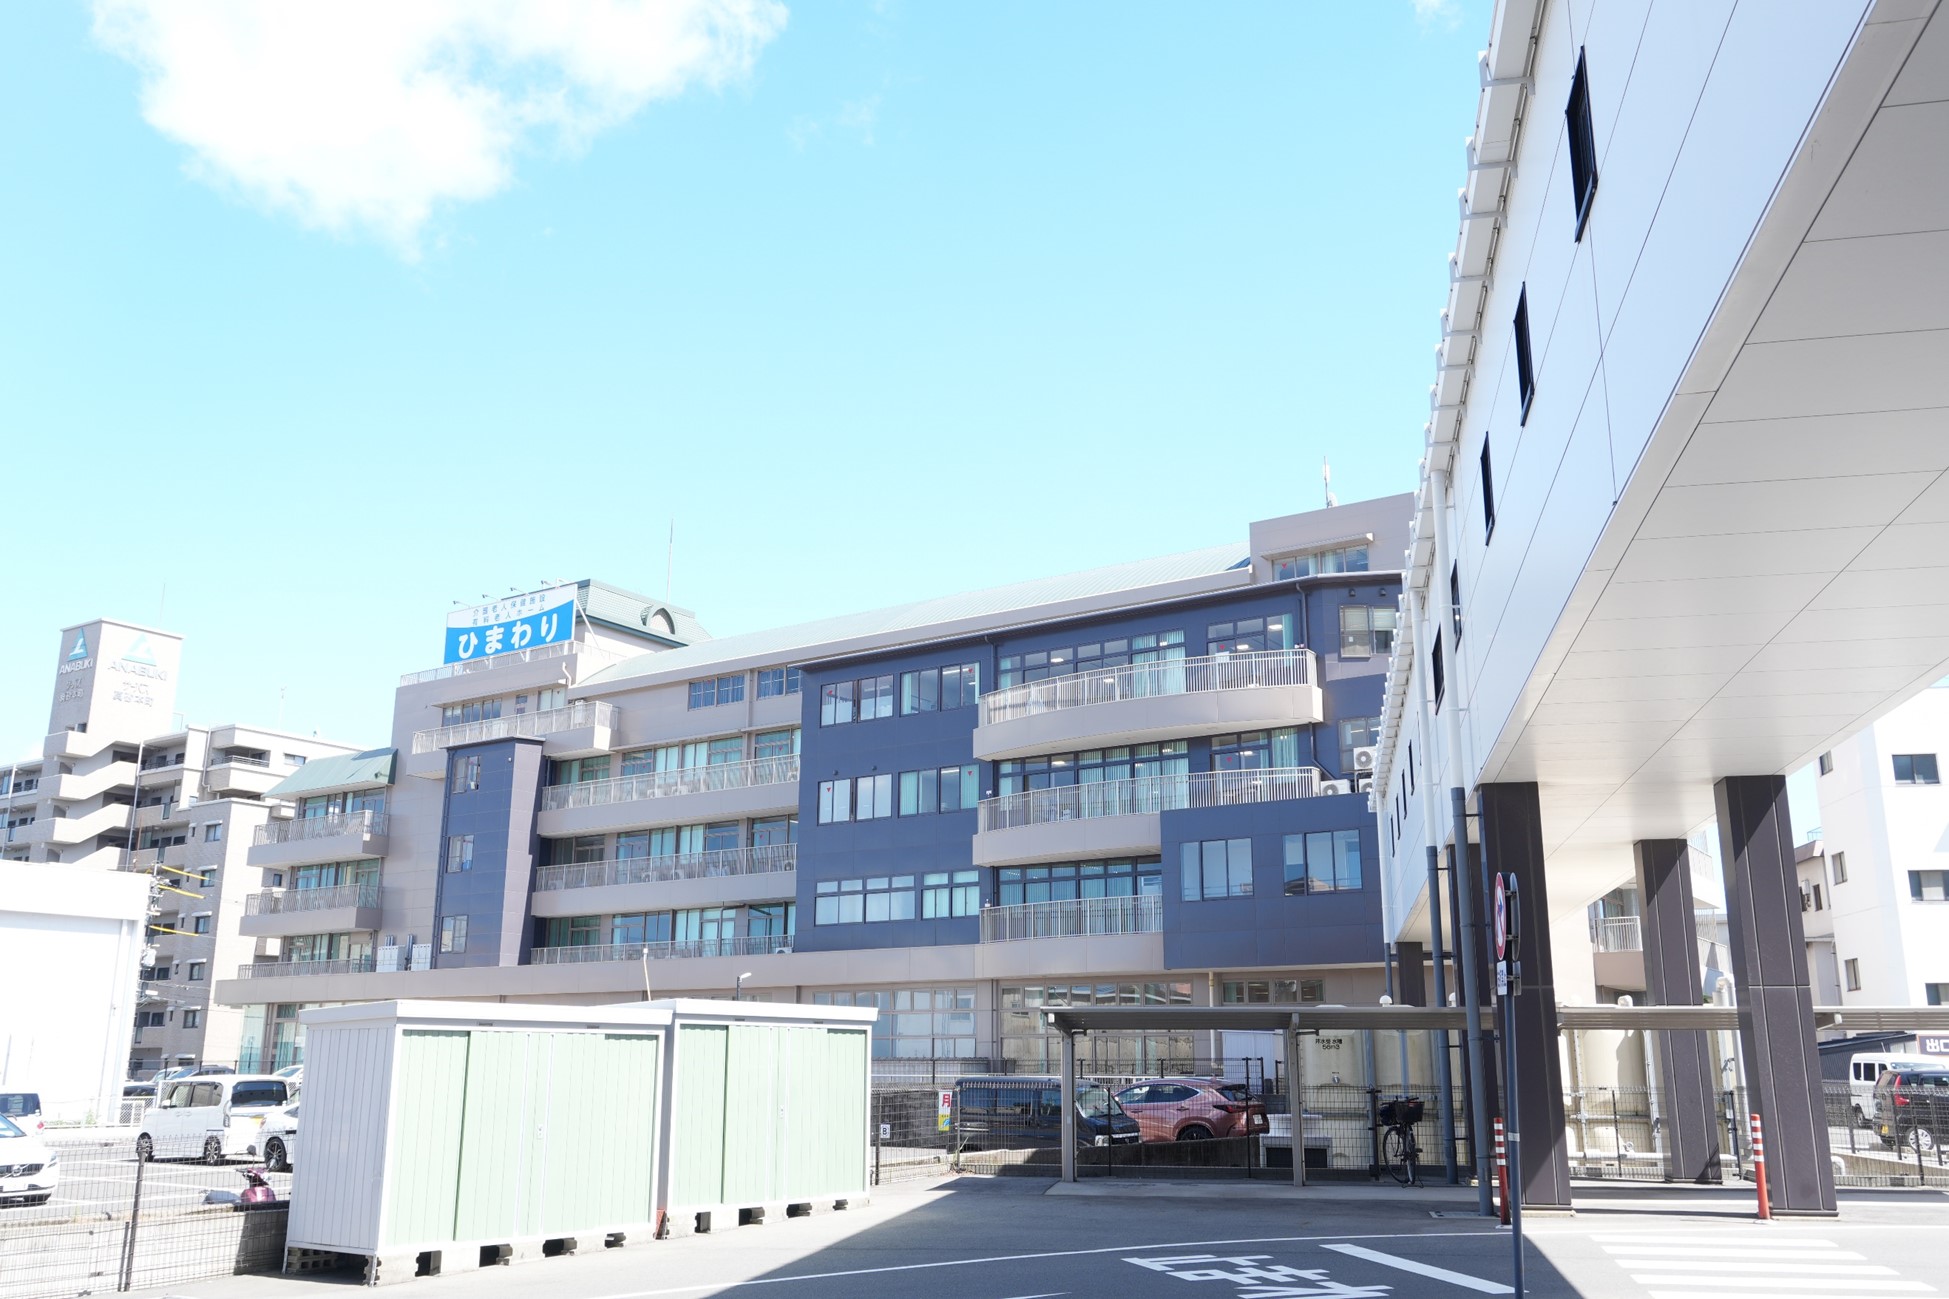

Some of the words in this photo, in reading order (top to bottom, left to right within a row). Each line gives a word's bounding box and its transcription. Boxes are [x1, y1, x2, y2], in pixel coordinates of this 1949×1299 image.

[472, 605, 545, 626] 有料老人ホーム
[458, 613, 558, 658] ひまわり
[59, 659, 93, 675] ANABUKI
[107, 661, 168, 681] ANABUKI
